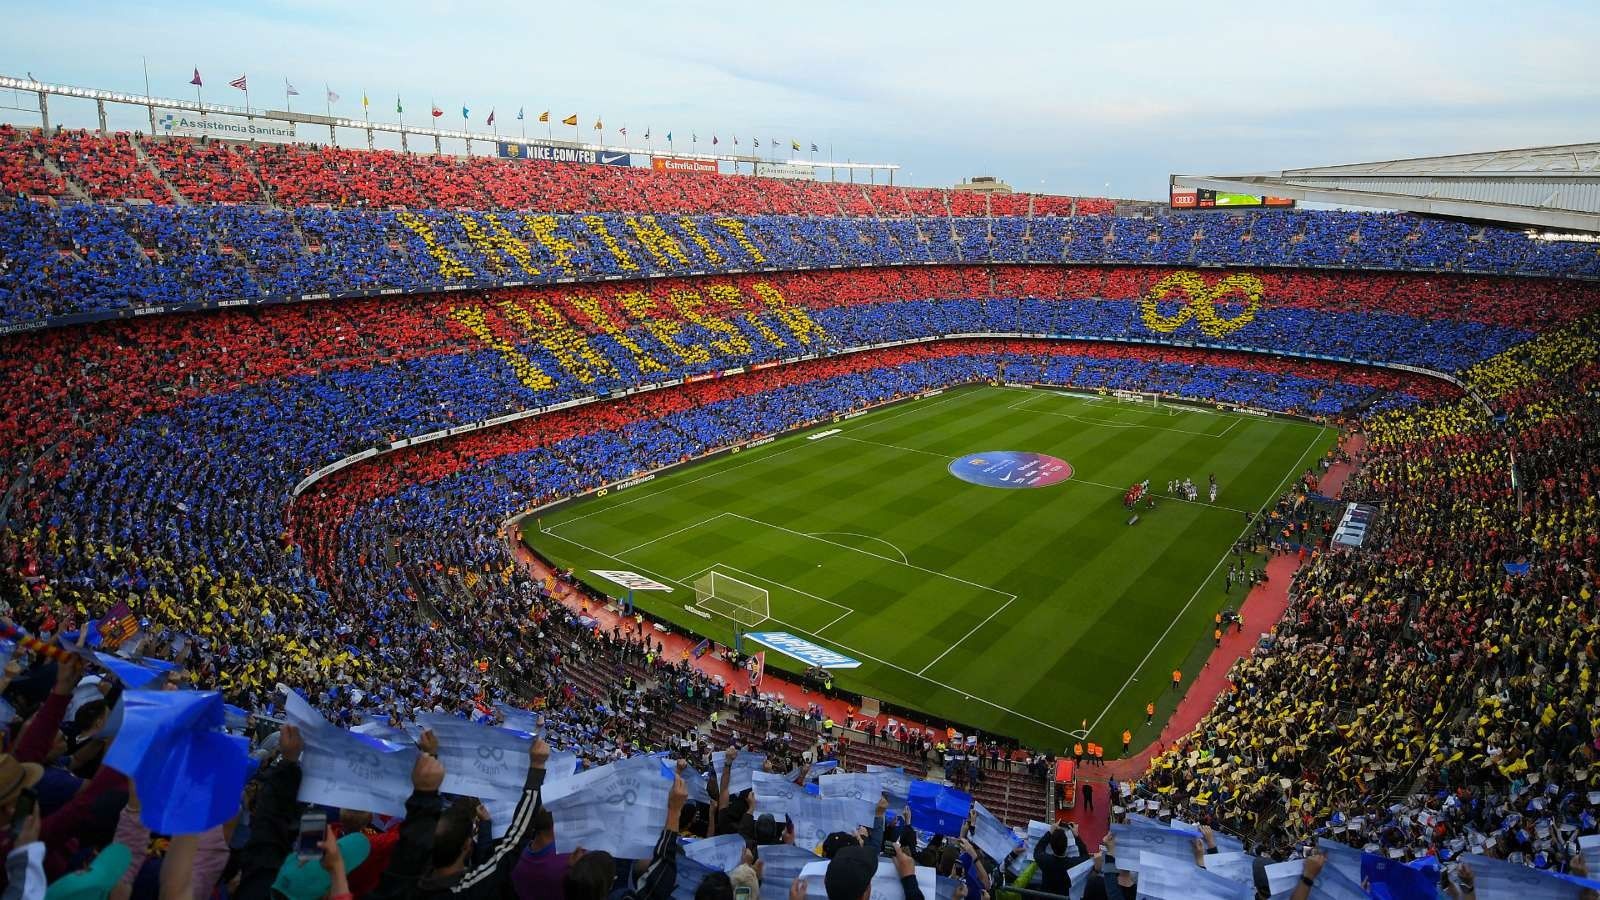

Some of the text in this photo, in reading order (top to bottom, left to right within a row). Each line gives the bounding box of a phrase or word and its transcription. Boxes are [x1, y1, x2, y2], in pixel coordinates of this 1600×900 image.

[527, 146, 596, 163] NIKE.COM/FCB
[665, 160, 716, 172] Estrella Damm
